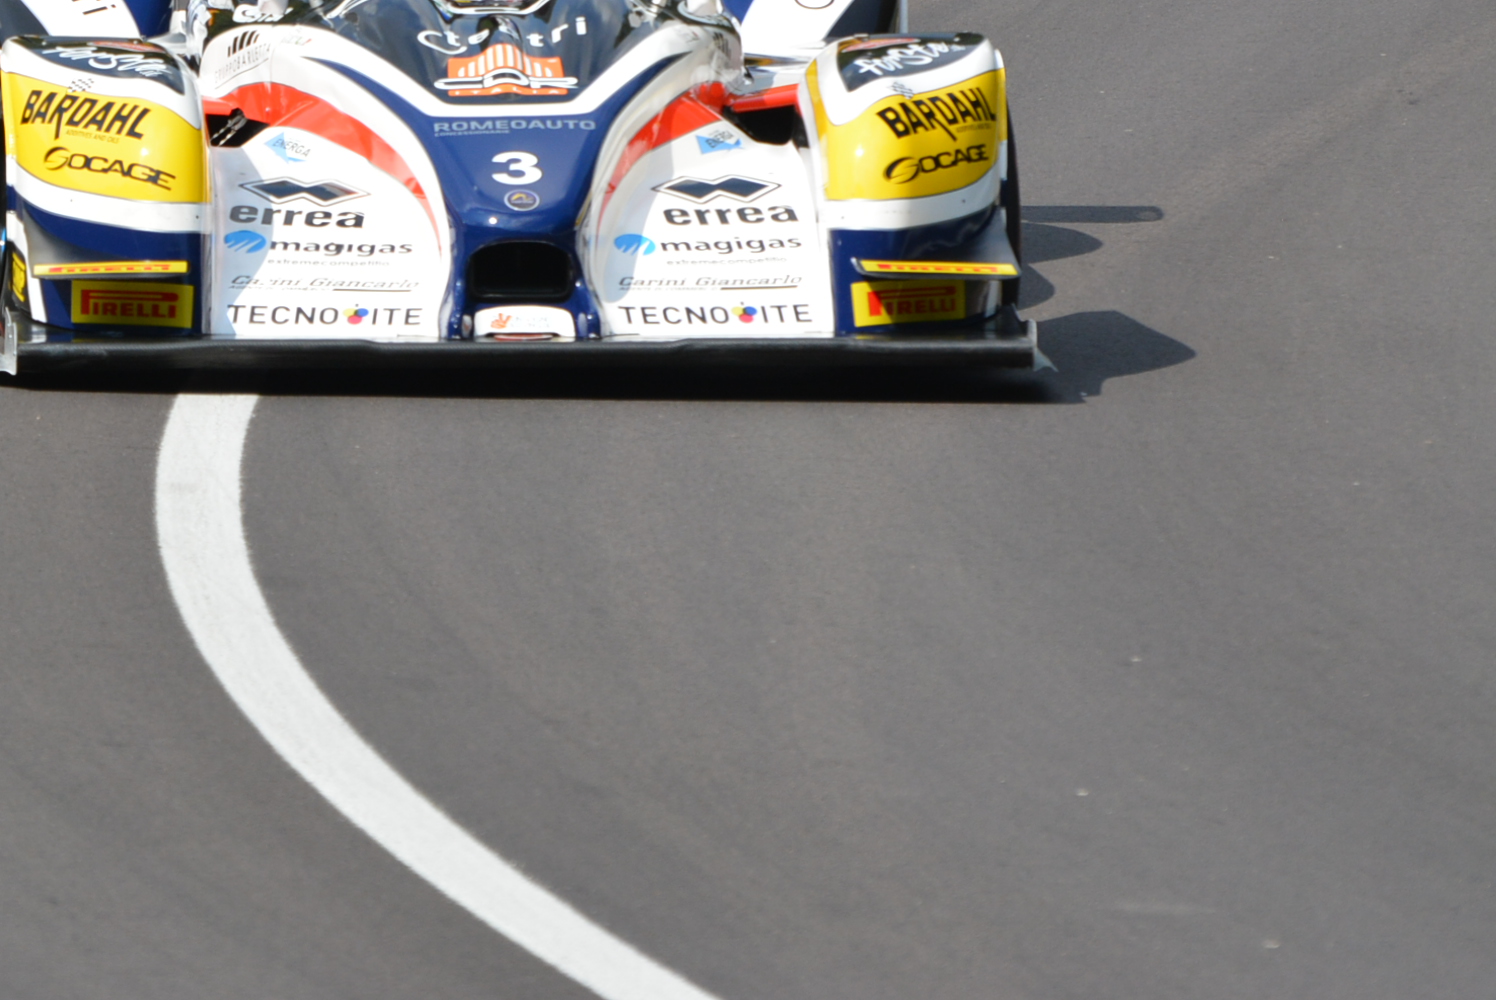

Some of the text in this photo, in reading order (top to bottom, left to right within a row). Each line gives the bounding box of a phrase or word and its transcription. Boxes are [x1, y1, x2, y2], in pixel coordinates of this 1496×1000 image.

[20, 90, 152, 141] BARDAHL
[875, 87, 997, 142] BARDAHL
[491, 151, 543, 186] 3
[270, 240, 413, 257] magigas
[660, 236, 802, 255] magigas
[618, 274, 802, 287] Carini Giancarlo
[81, 288, 179, 318] PIRELLI
[867, 286, 957, 317] PIRELLI
